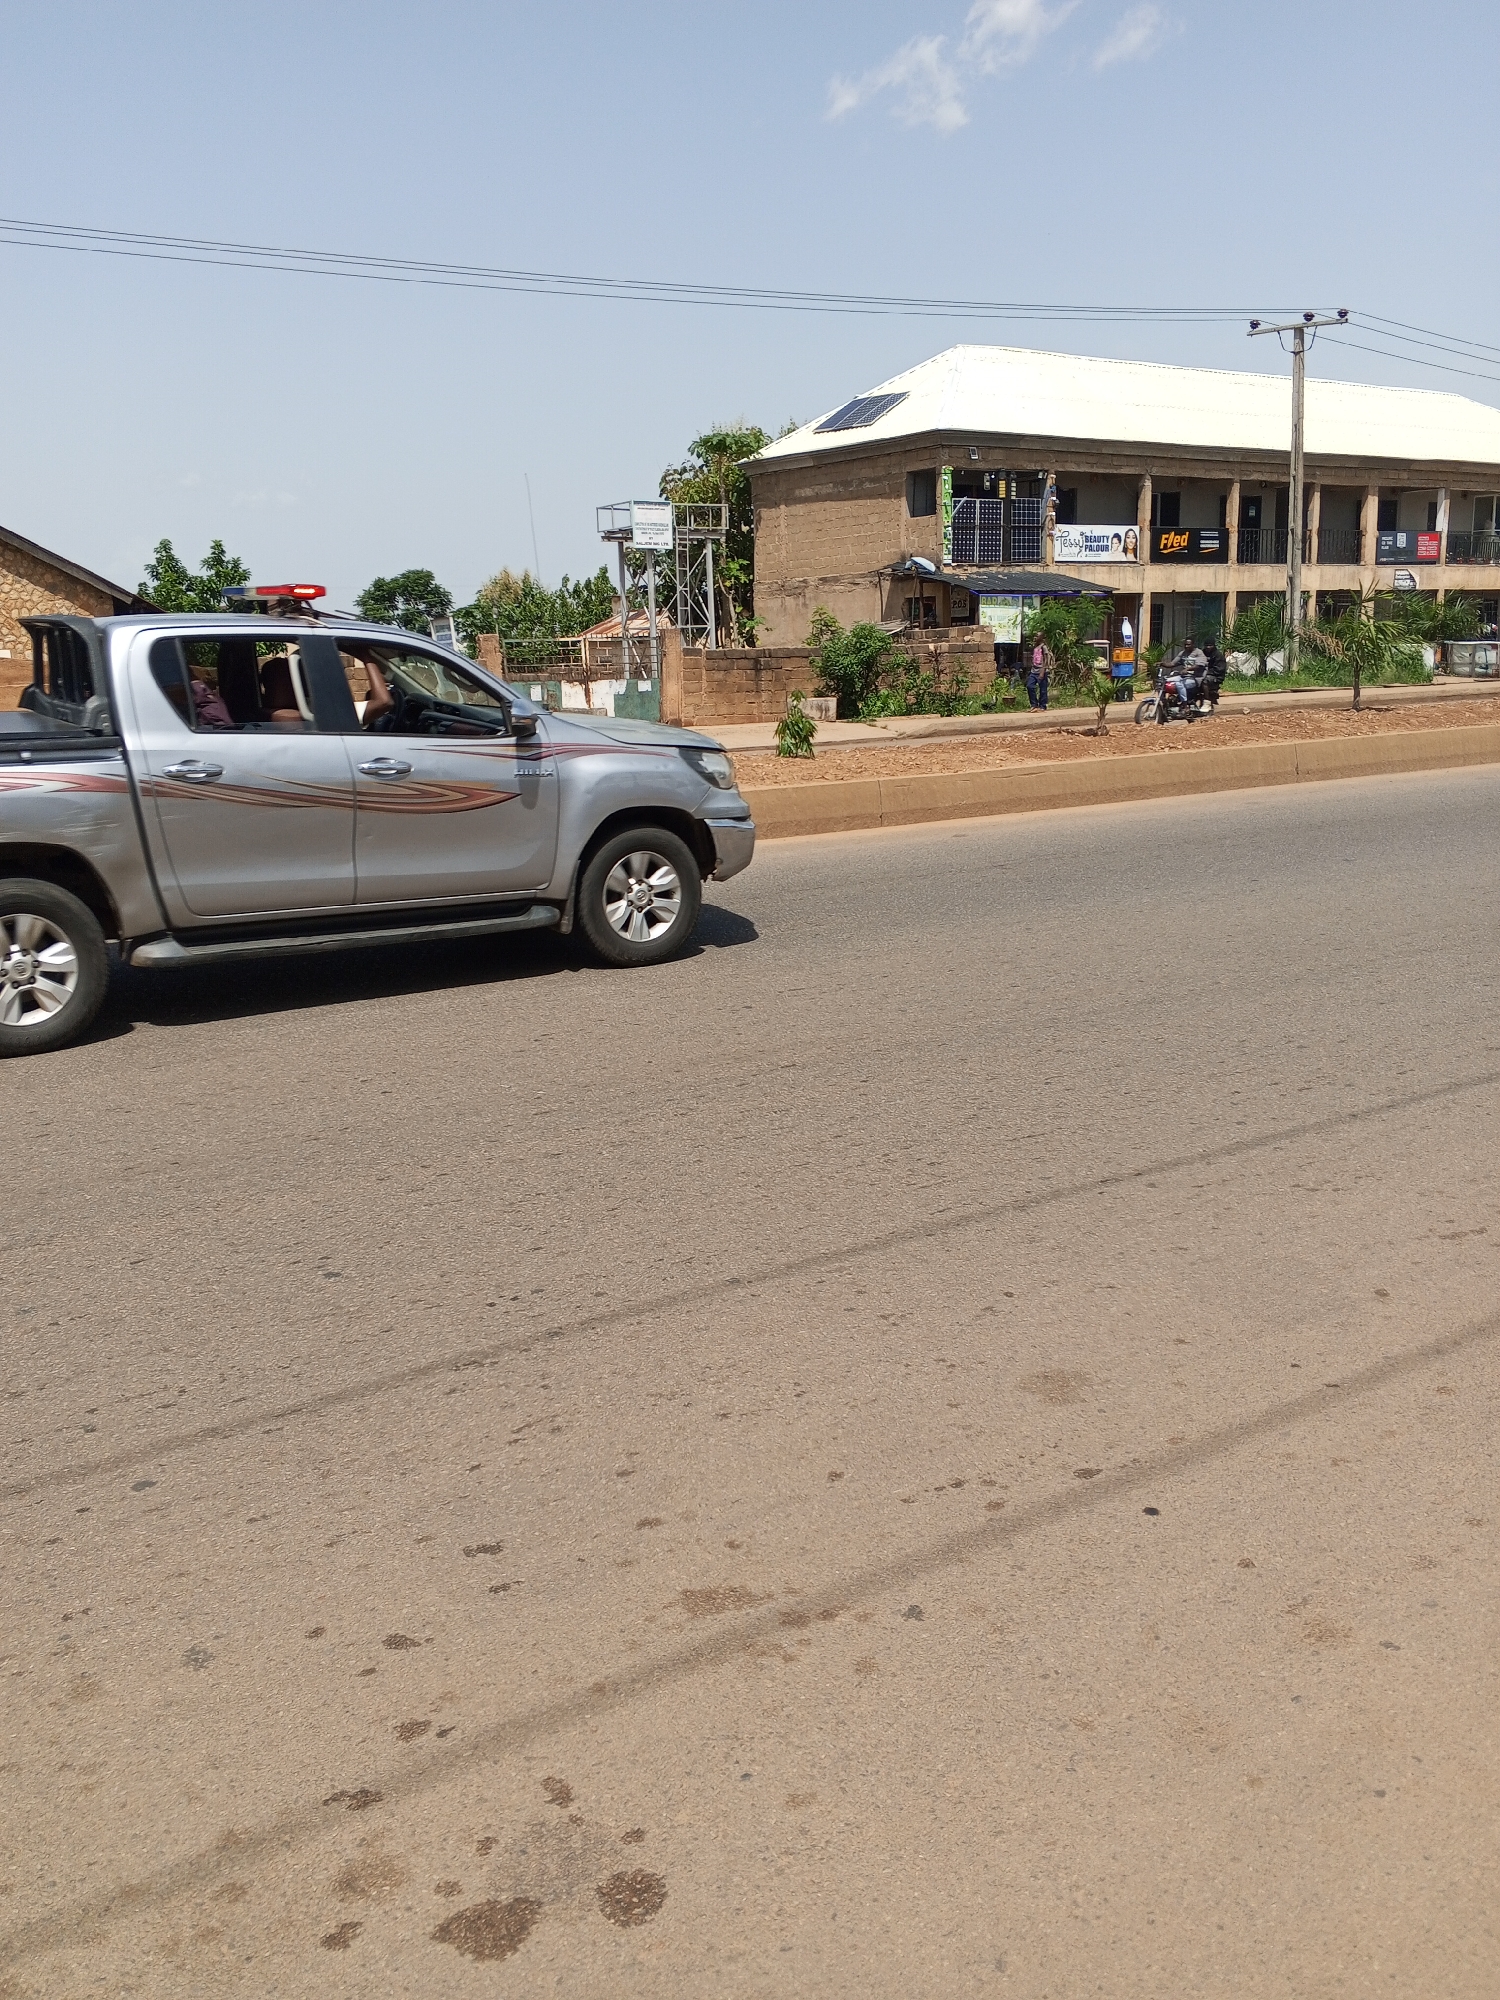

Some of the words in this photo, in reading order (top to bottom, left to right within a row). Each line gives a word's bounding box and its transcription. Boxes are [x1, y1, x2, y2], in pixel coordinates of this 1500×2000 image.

[1056, 530, 1085, 558] Tessy
[1085, 535, 1110, 544] BEAUTY
[1085, 544, 1110, 553] PALOUR
